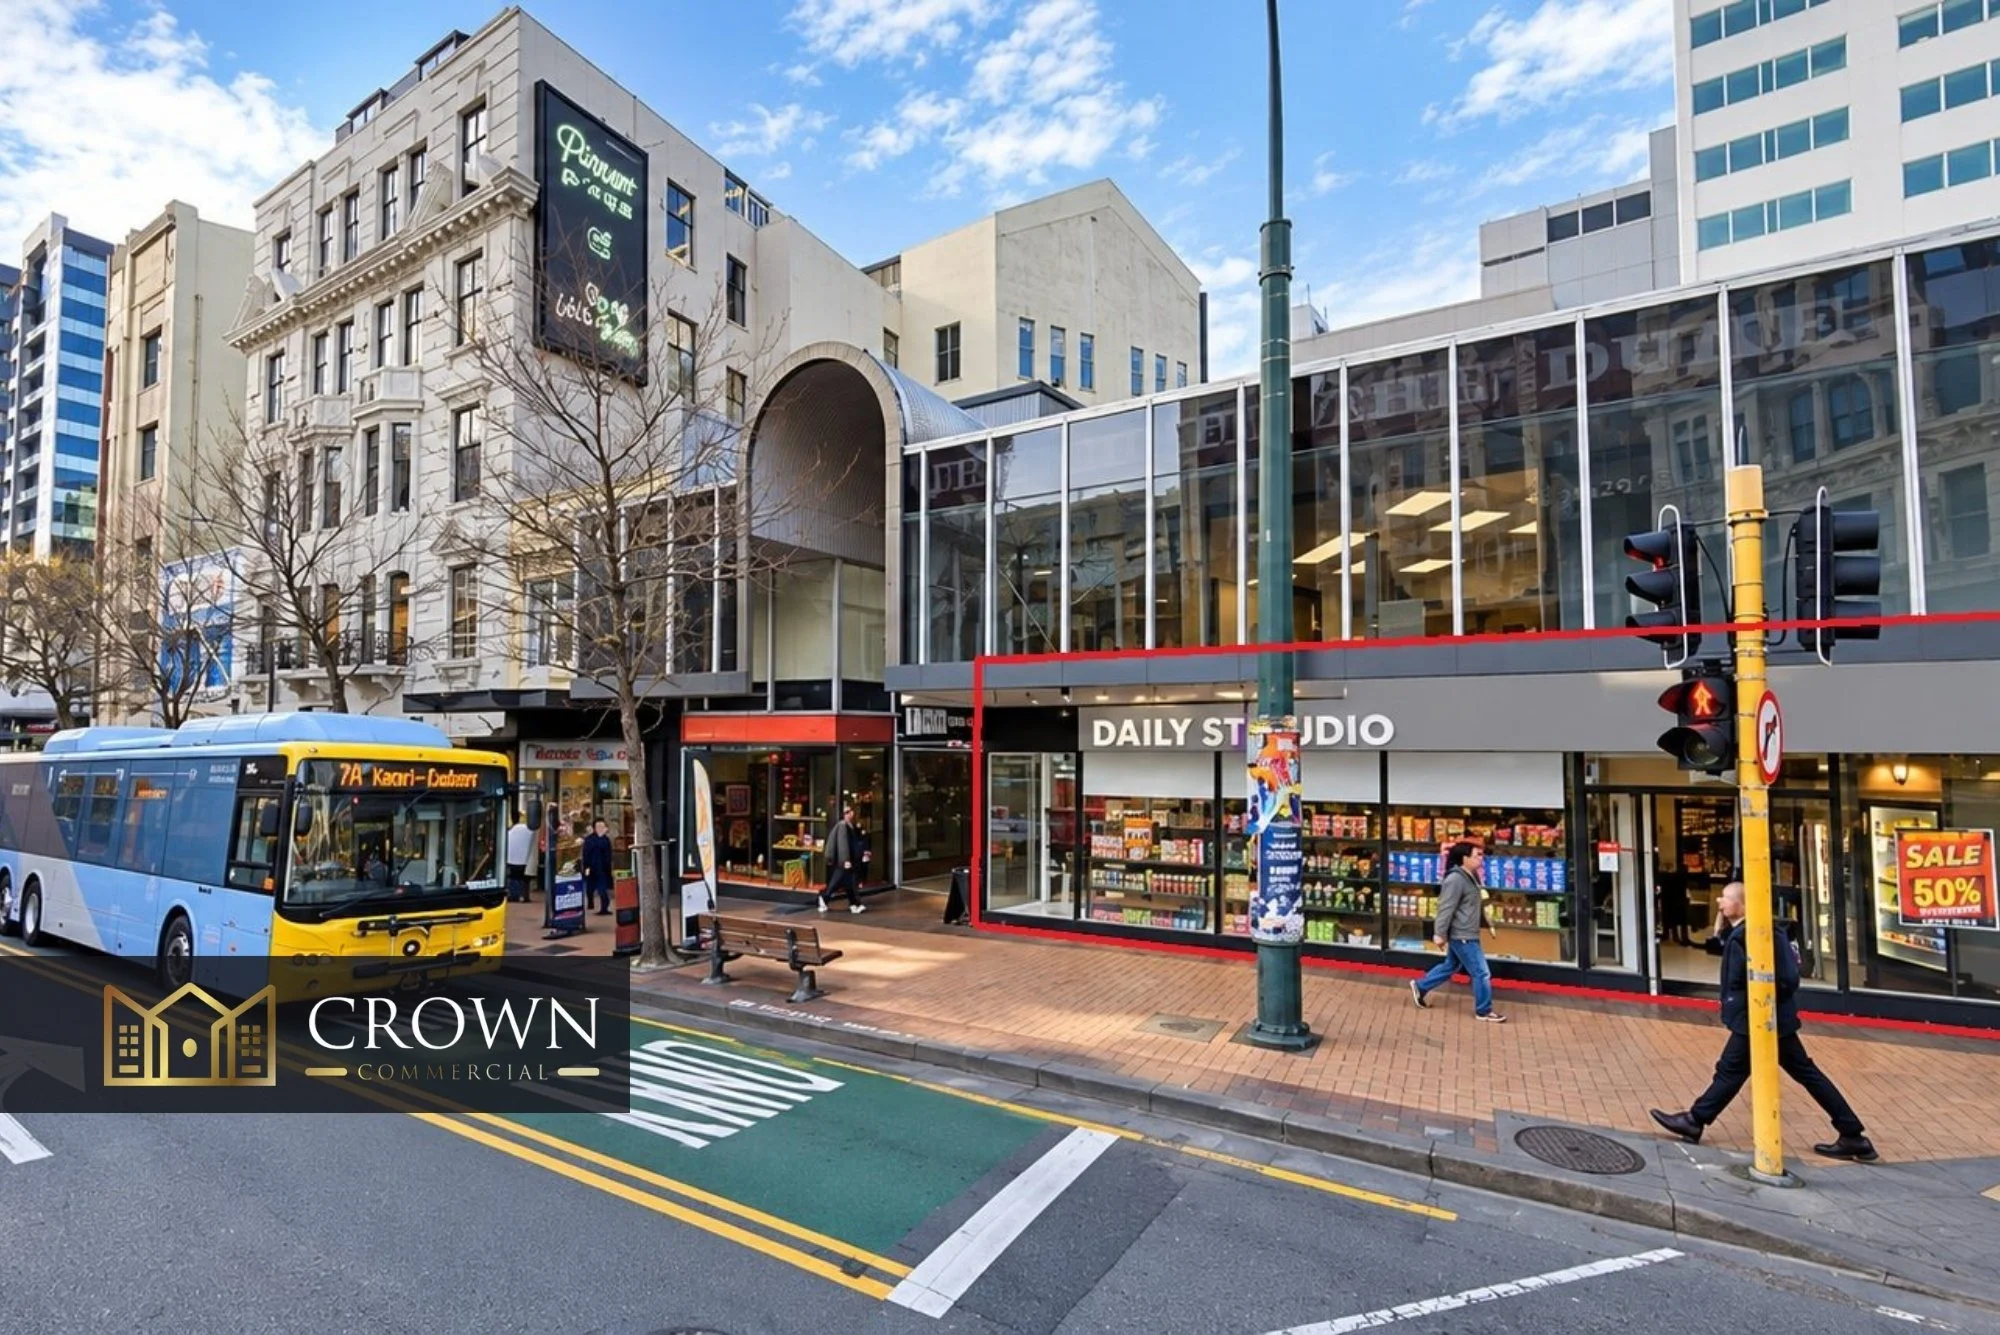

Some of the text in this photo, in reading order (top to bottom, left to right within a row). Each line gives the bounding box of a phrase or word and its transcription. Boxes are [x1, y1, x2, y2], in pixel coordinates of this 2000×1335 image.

[1092, 718, 1192, 747] DAILY
[339, 762, 363, 787] 7A
[1905, 844, 1982, 869] SALE
[1913, 876, 1982, 908] 50%
